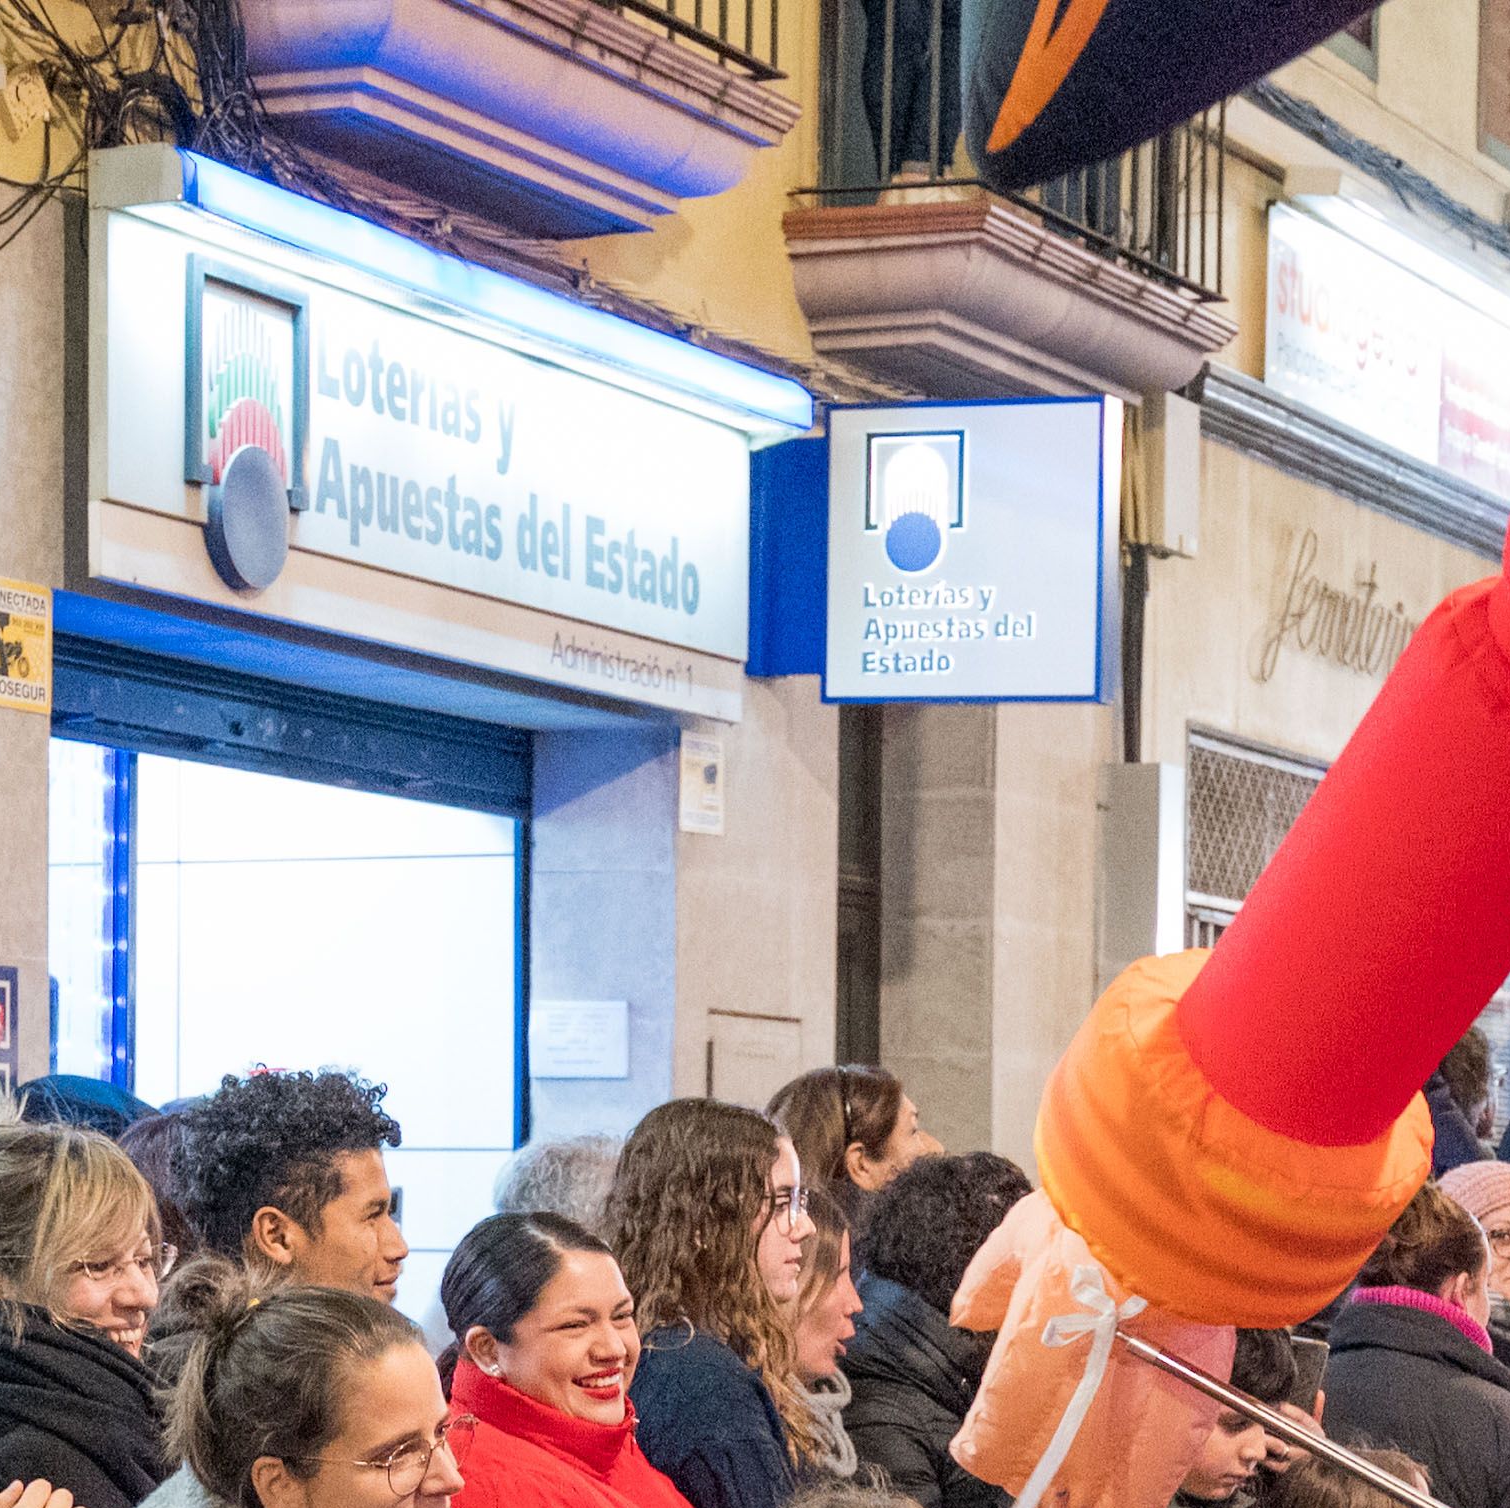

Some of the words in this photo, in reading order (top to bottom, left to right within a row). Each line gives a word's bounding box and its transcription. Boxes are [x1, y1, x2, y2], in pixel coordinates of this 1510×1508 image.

[497, 396, 516, 475] y
[316, 437, 503, 562] Apuestas
[516, 493, 571, 581] del
[585, 514, 700, 615] Estado
[978, 588, 993, 612] y
[863, 616, 987, 646] Apuestas
[994, 613, 1033, 638] del
[861, 648, 951, 674] Estado
[686, 663, 694, 697] 1
